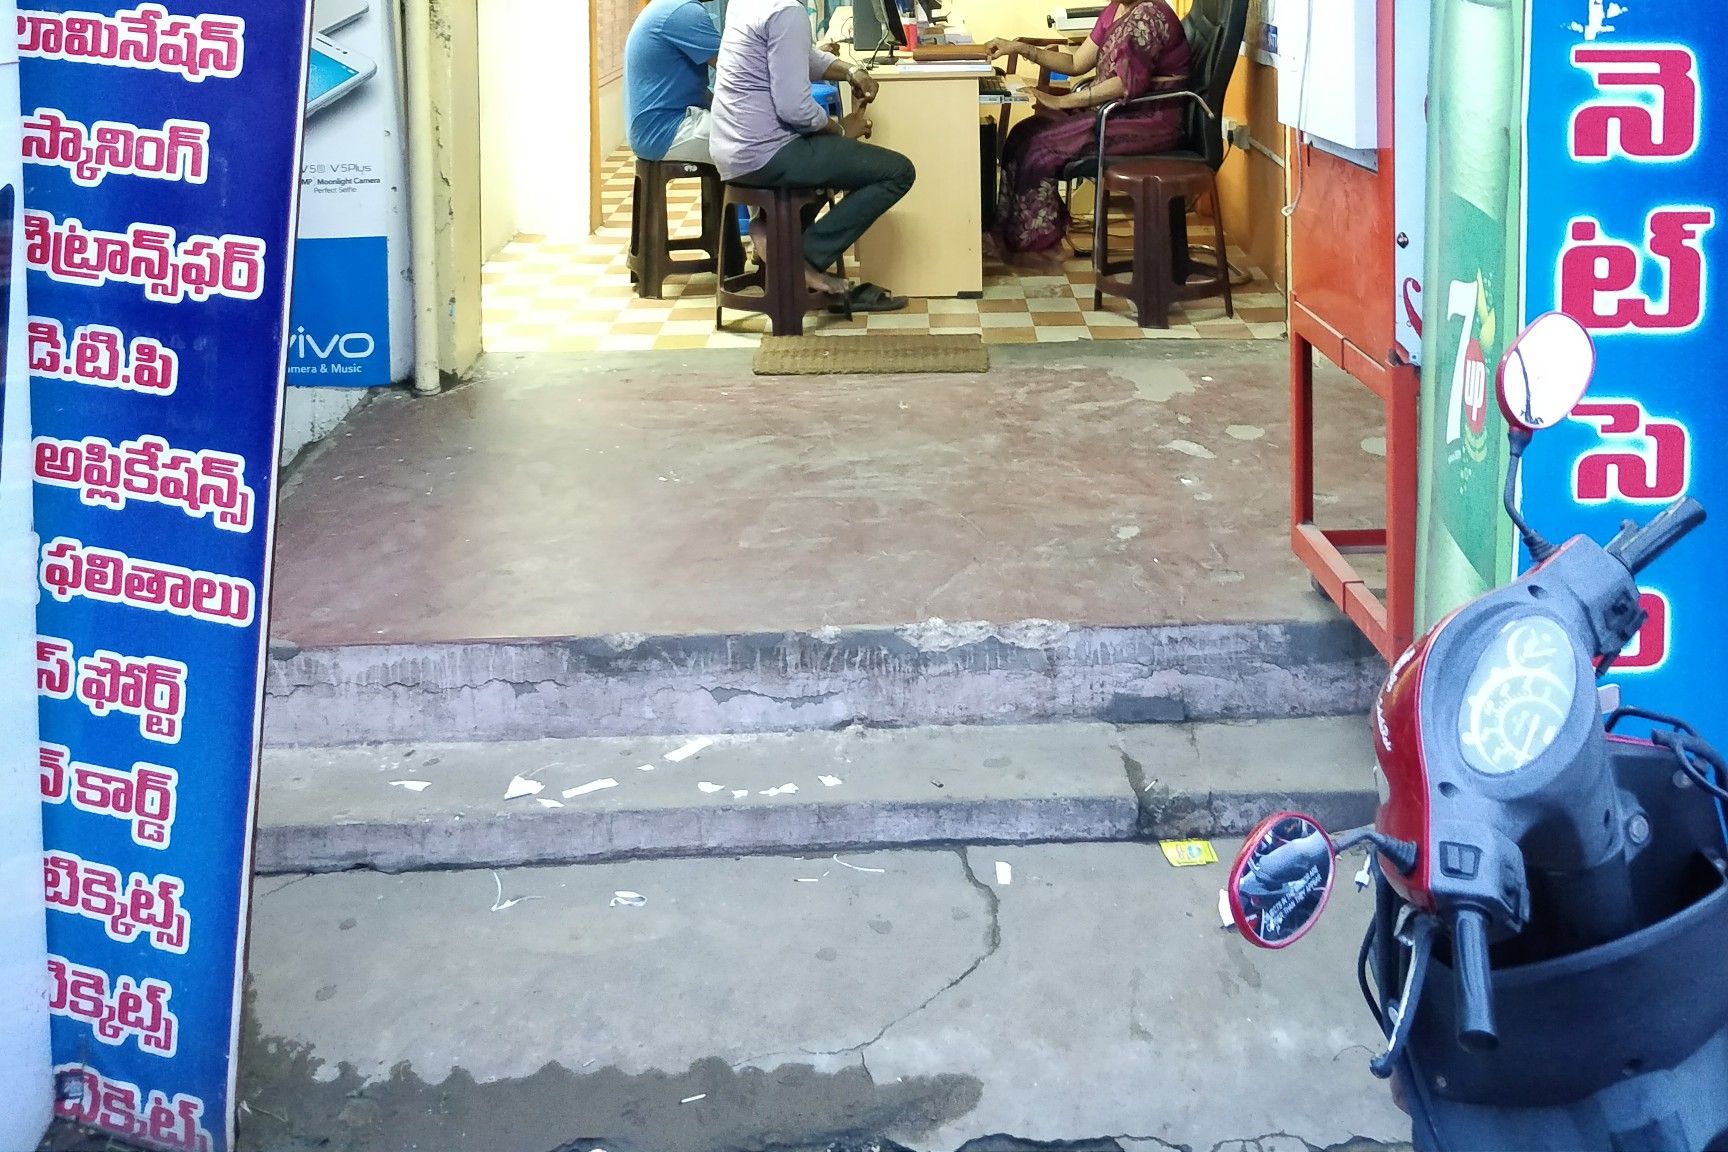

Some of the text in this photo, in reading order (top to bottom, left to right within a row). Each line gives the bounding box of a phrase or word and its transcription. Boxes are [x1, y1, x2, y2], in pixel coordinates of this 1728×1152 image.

[22, 112, 207, 182] స్కానింగ్
[319, 364, 329, 374] &
[331, 363, 362, 374] Music
[44, 542, 252, 621] ఫలితాలు
[74, 767, 174, 844] కార్డ్
